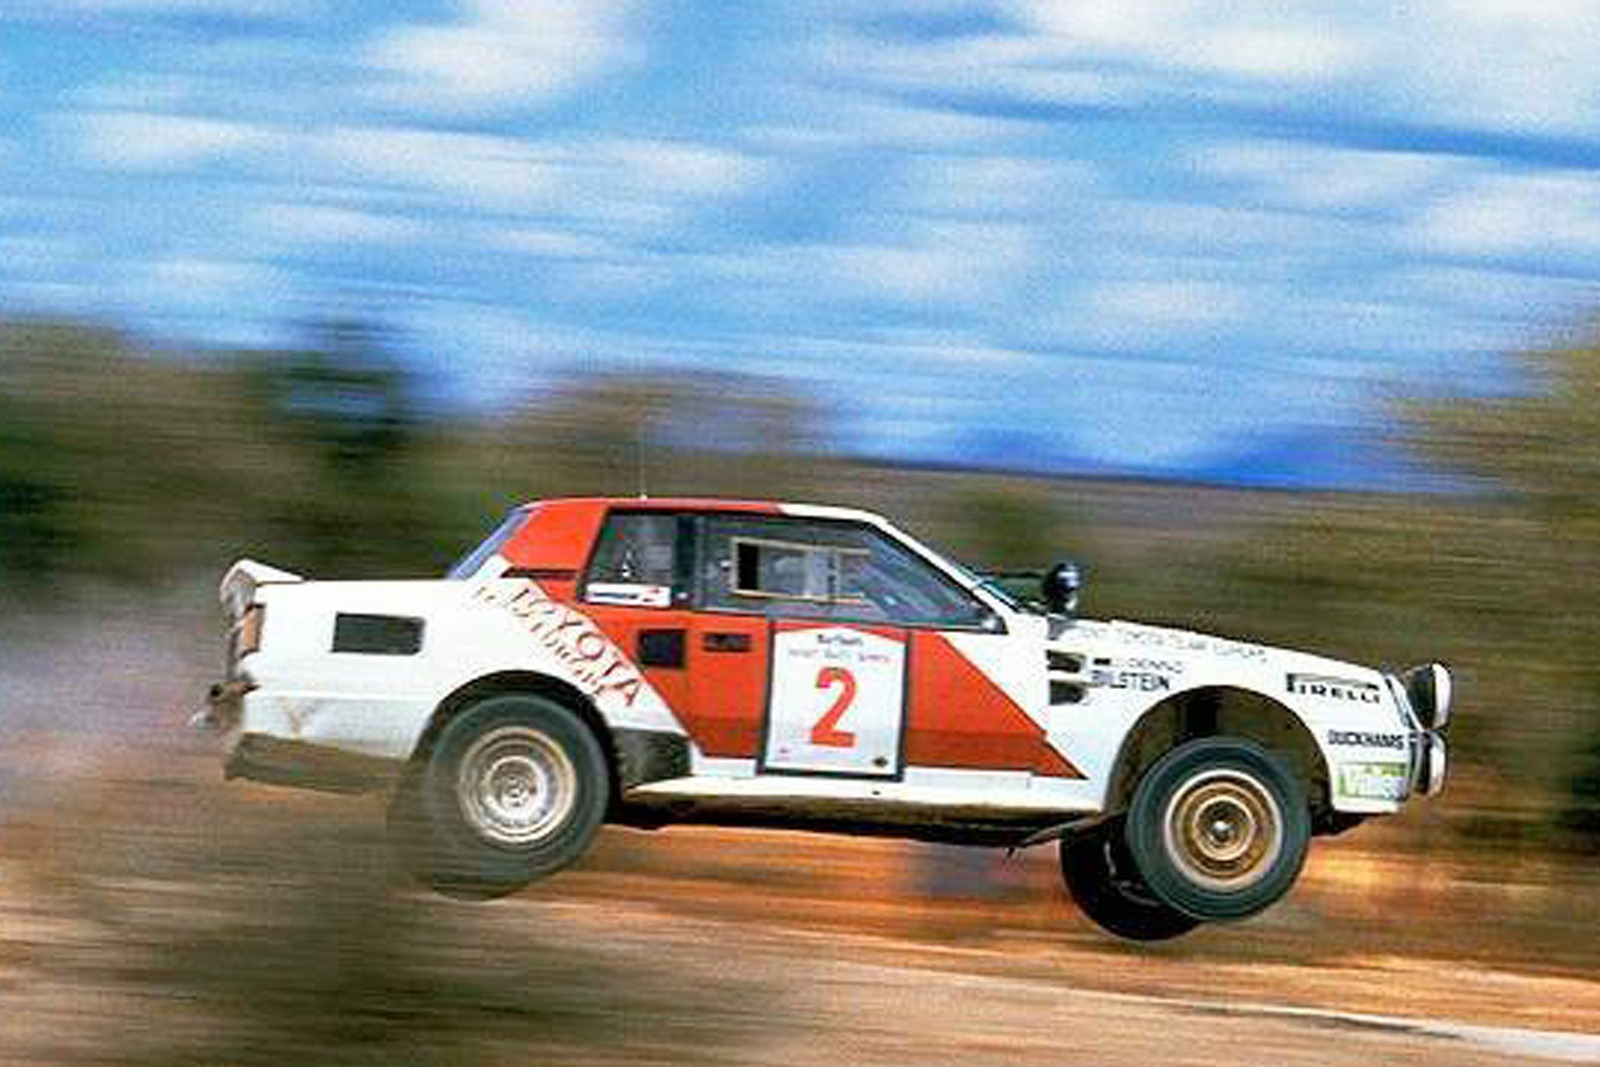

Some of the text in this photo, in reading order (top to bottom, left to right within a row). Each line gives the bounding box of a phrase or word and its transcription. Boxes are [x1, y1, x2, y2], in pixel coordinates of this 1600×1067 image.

[1091, 670, 1171, 691] BILSTEIN
[1286, 672, 1380, 704] PIRELLI
[811, 666, 858, 748] 2
[1327, 729, 1405, 750] DUCKHAMS
